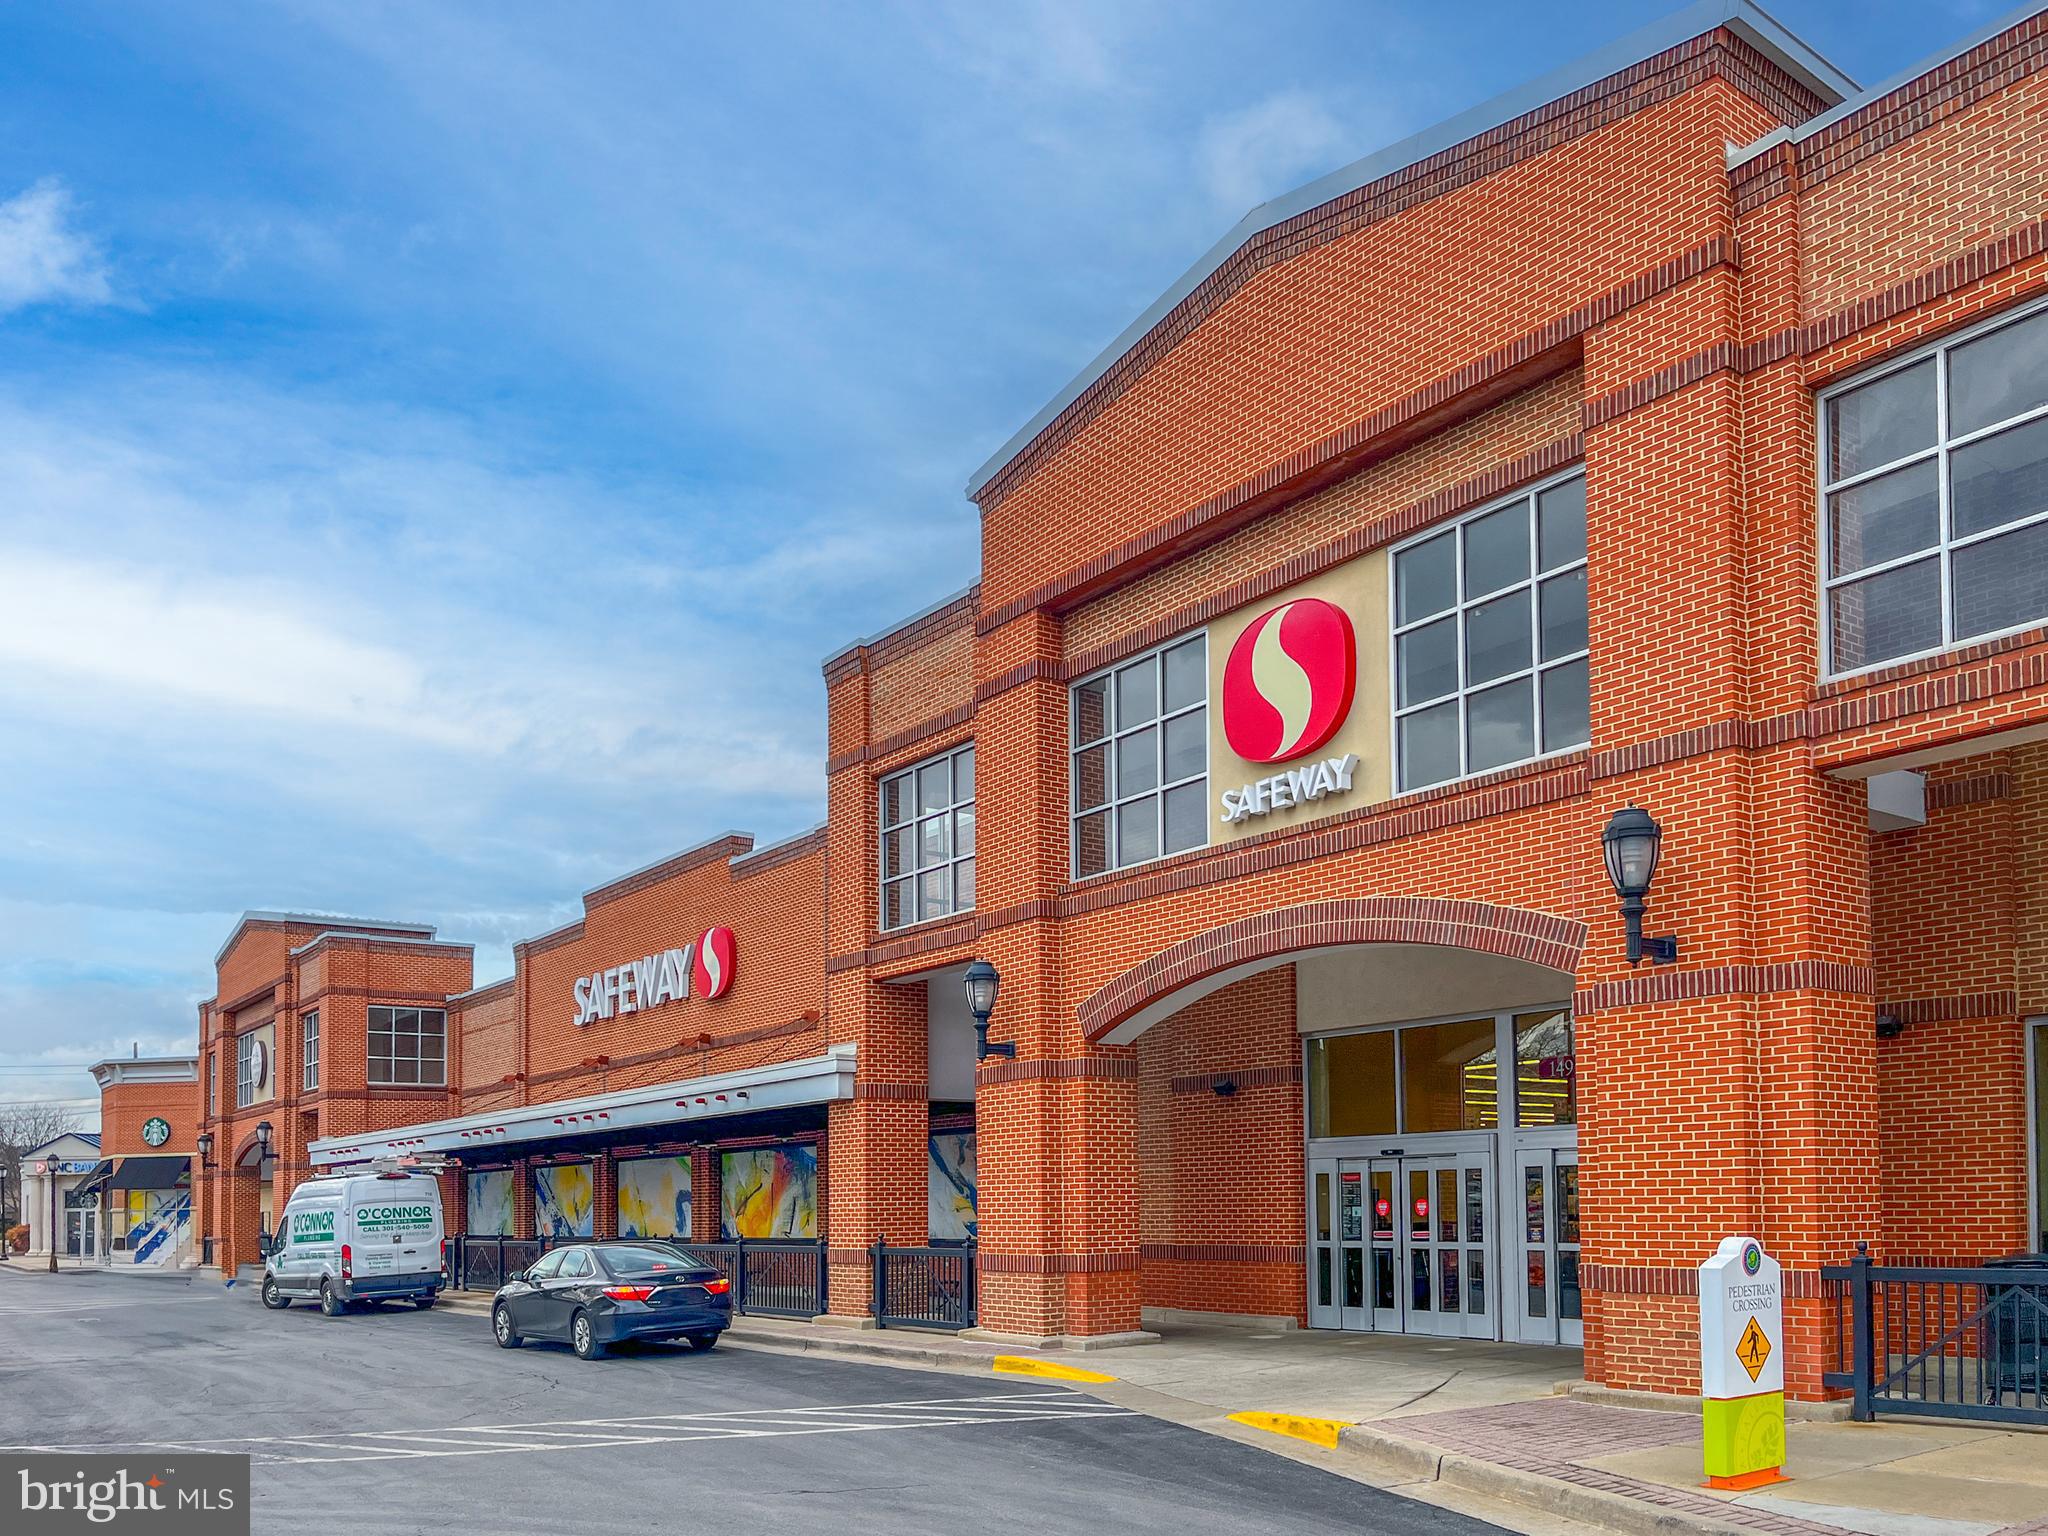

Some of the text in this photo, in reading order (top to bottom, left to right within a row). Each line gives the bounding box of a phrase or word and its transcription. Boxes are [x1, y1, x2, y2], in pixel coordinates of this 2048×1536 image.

[1221, 753, 1360, 823] SAFEWAY
[573, 943, 696, 1027] SAFEWAY
[1550, 1059, 1574, 1077] 149
[74, 1161, 97, 1173] BAN
[357, 1206, 432, 1220] O'CONNOR
[294, 1211, 334, 1233] O'CONNOR
[382, 1223, 430, 1232] 301-540-5050
[1728, 1283, 1775, 1298] PEDESTRIAN
[1732, 1297, 1772, 1312] CROSSING
